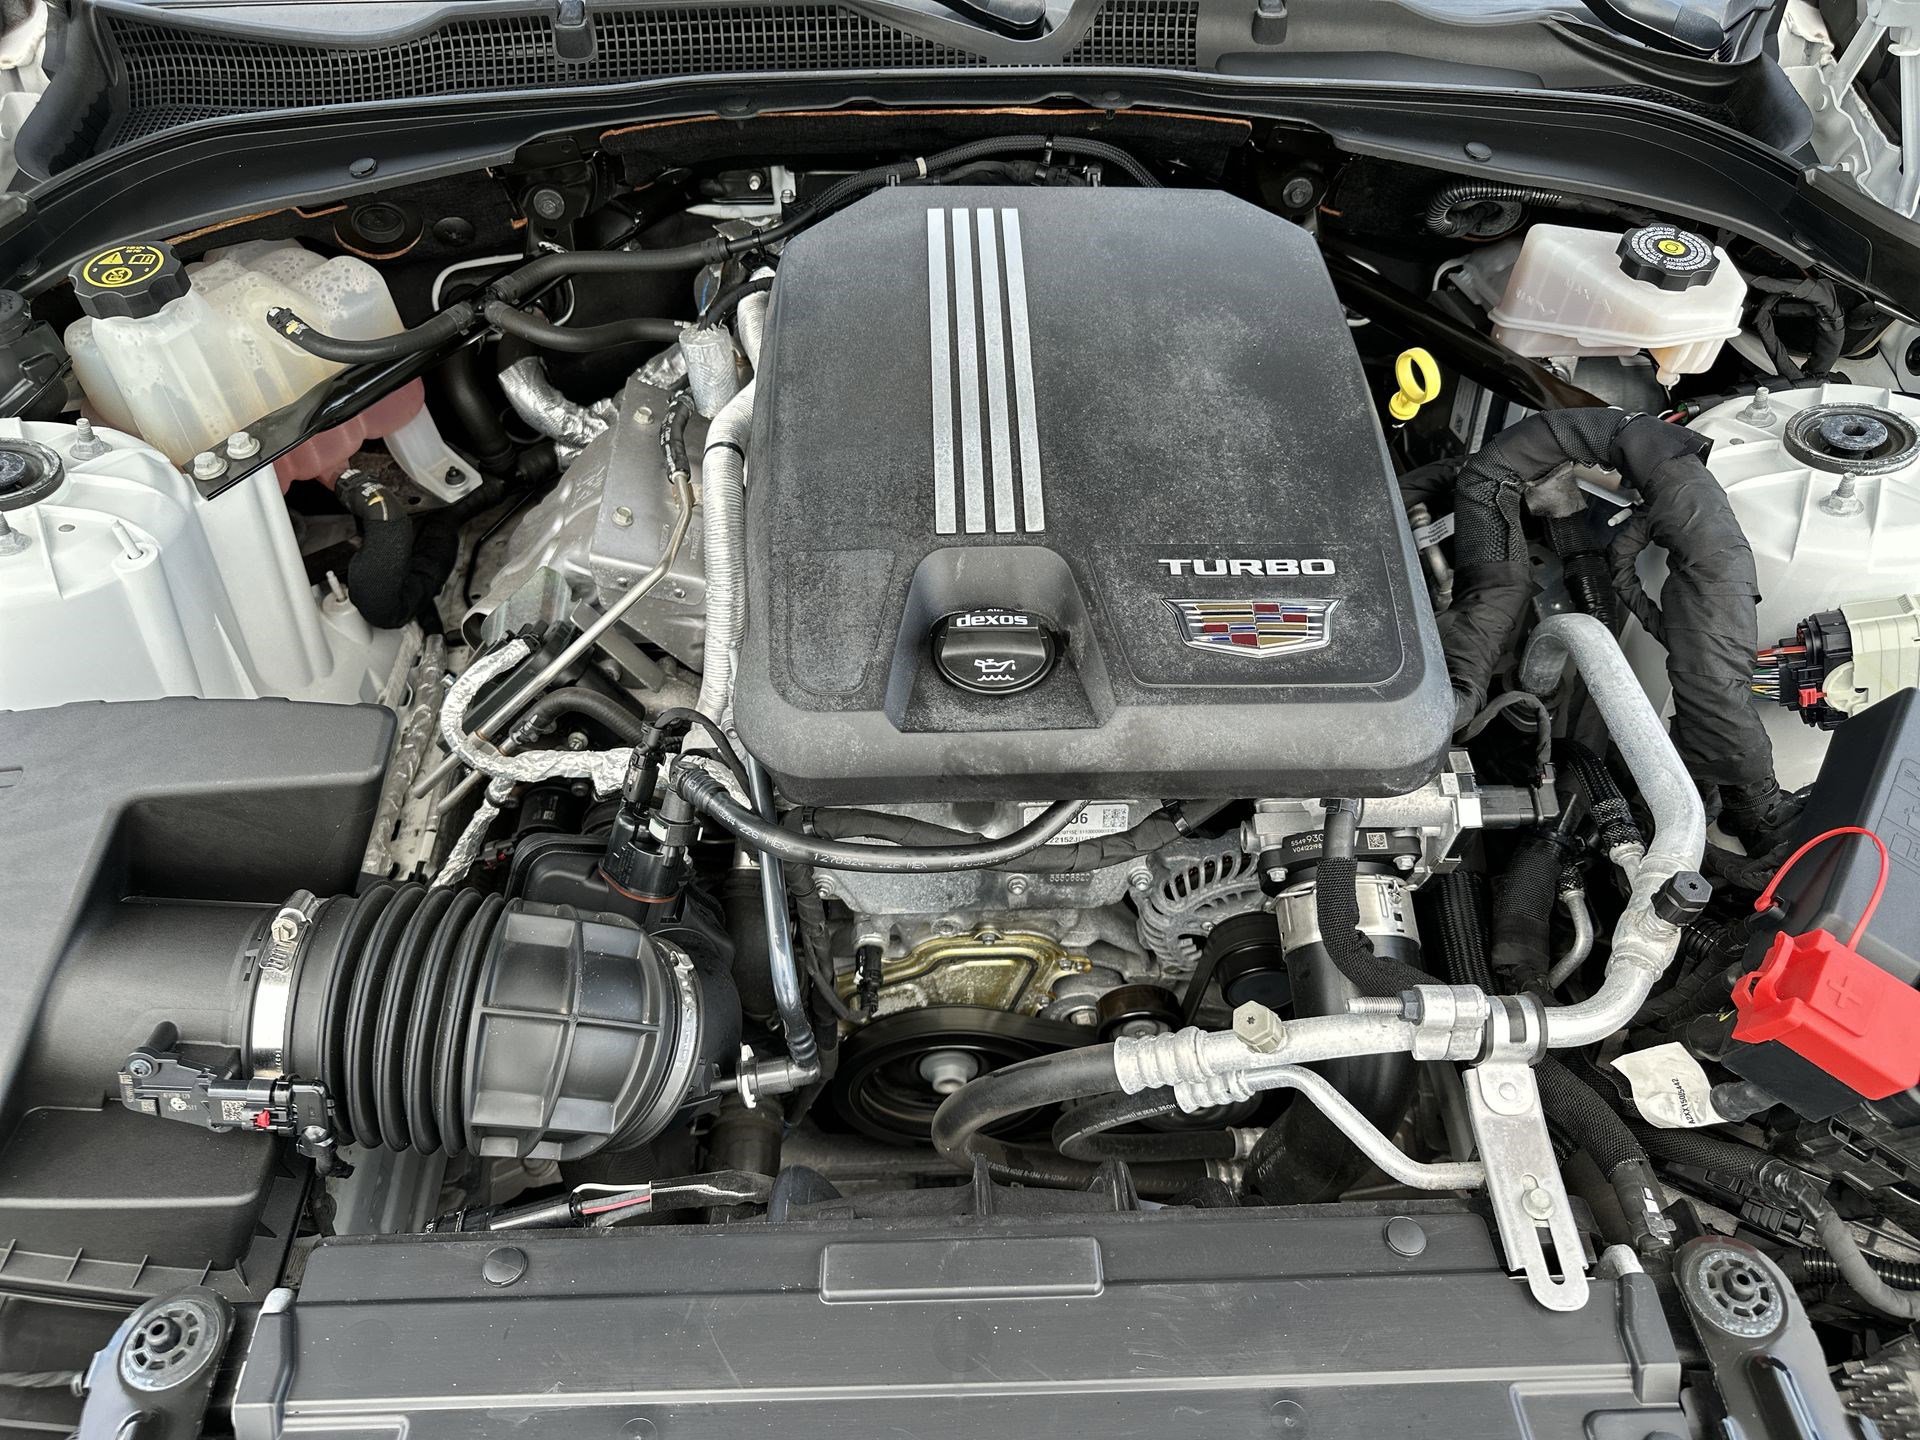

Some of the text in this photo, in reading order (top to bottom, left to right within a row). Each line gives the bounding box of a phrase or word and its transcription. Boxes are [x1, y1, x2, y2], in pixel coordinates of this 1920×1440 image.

[1158, 559, 1336, 576] TURBO
[956, 614, 1028, 627] dexos
[739, 823, 760, 840] 226
[765, 836, 791, 853] MEX
